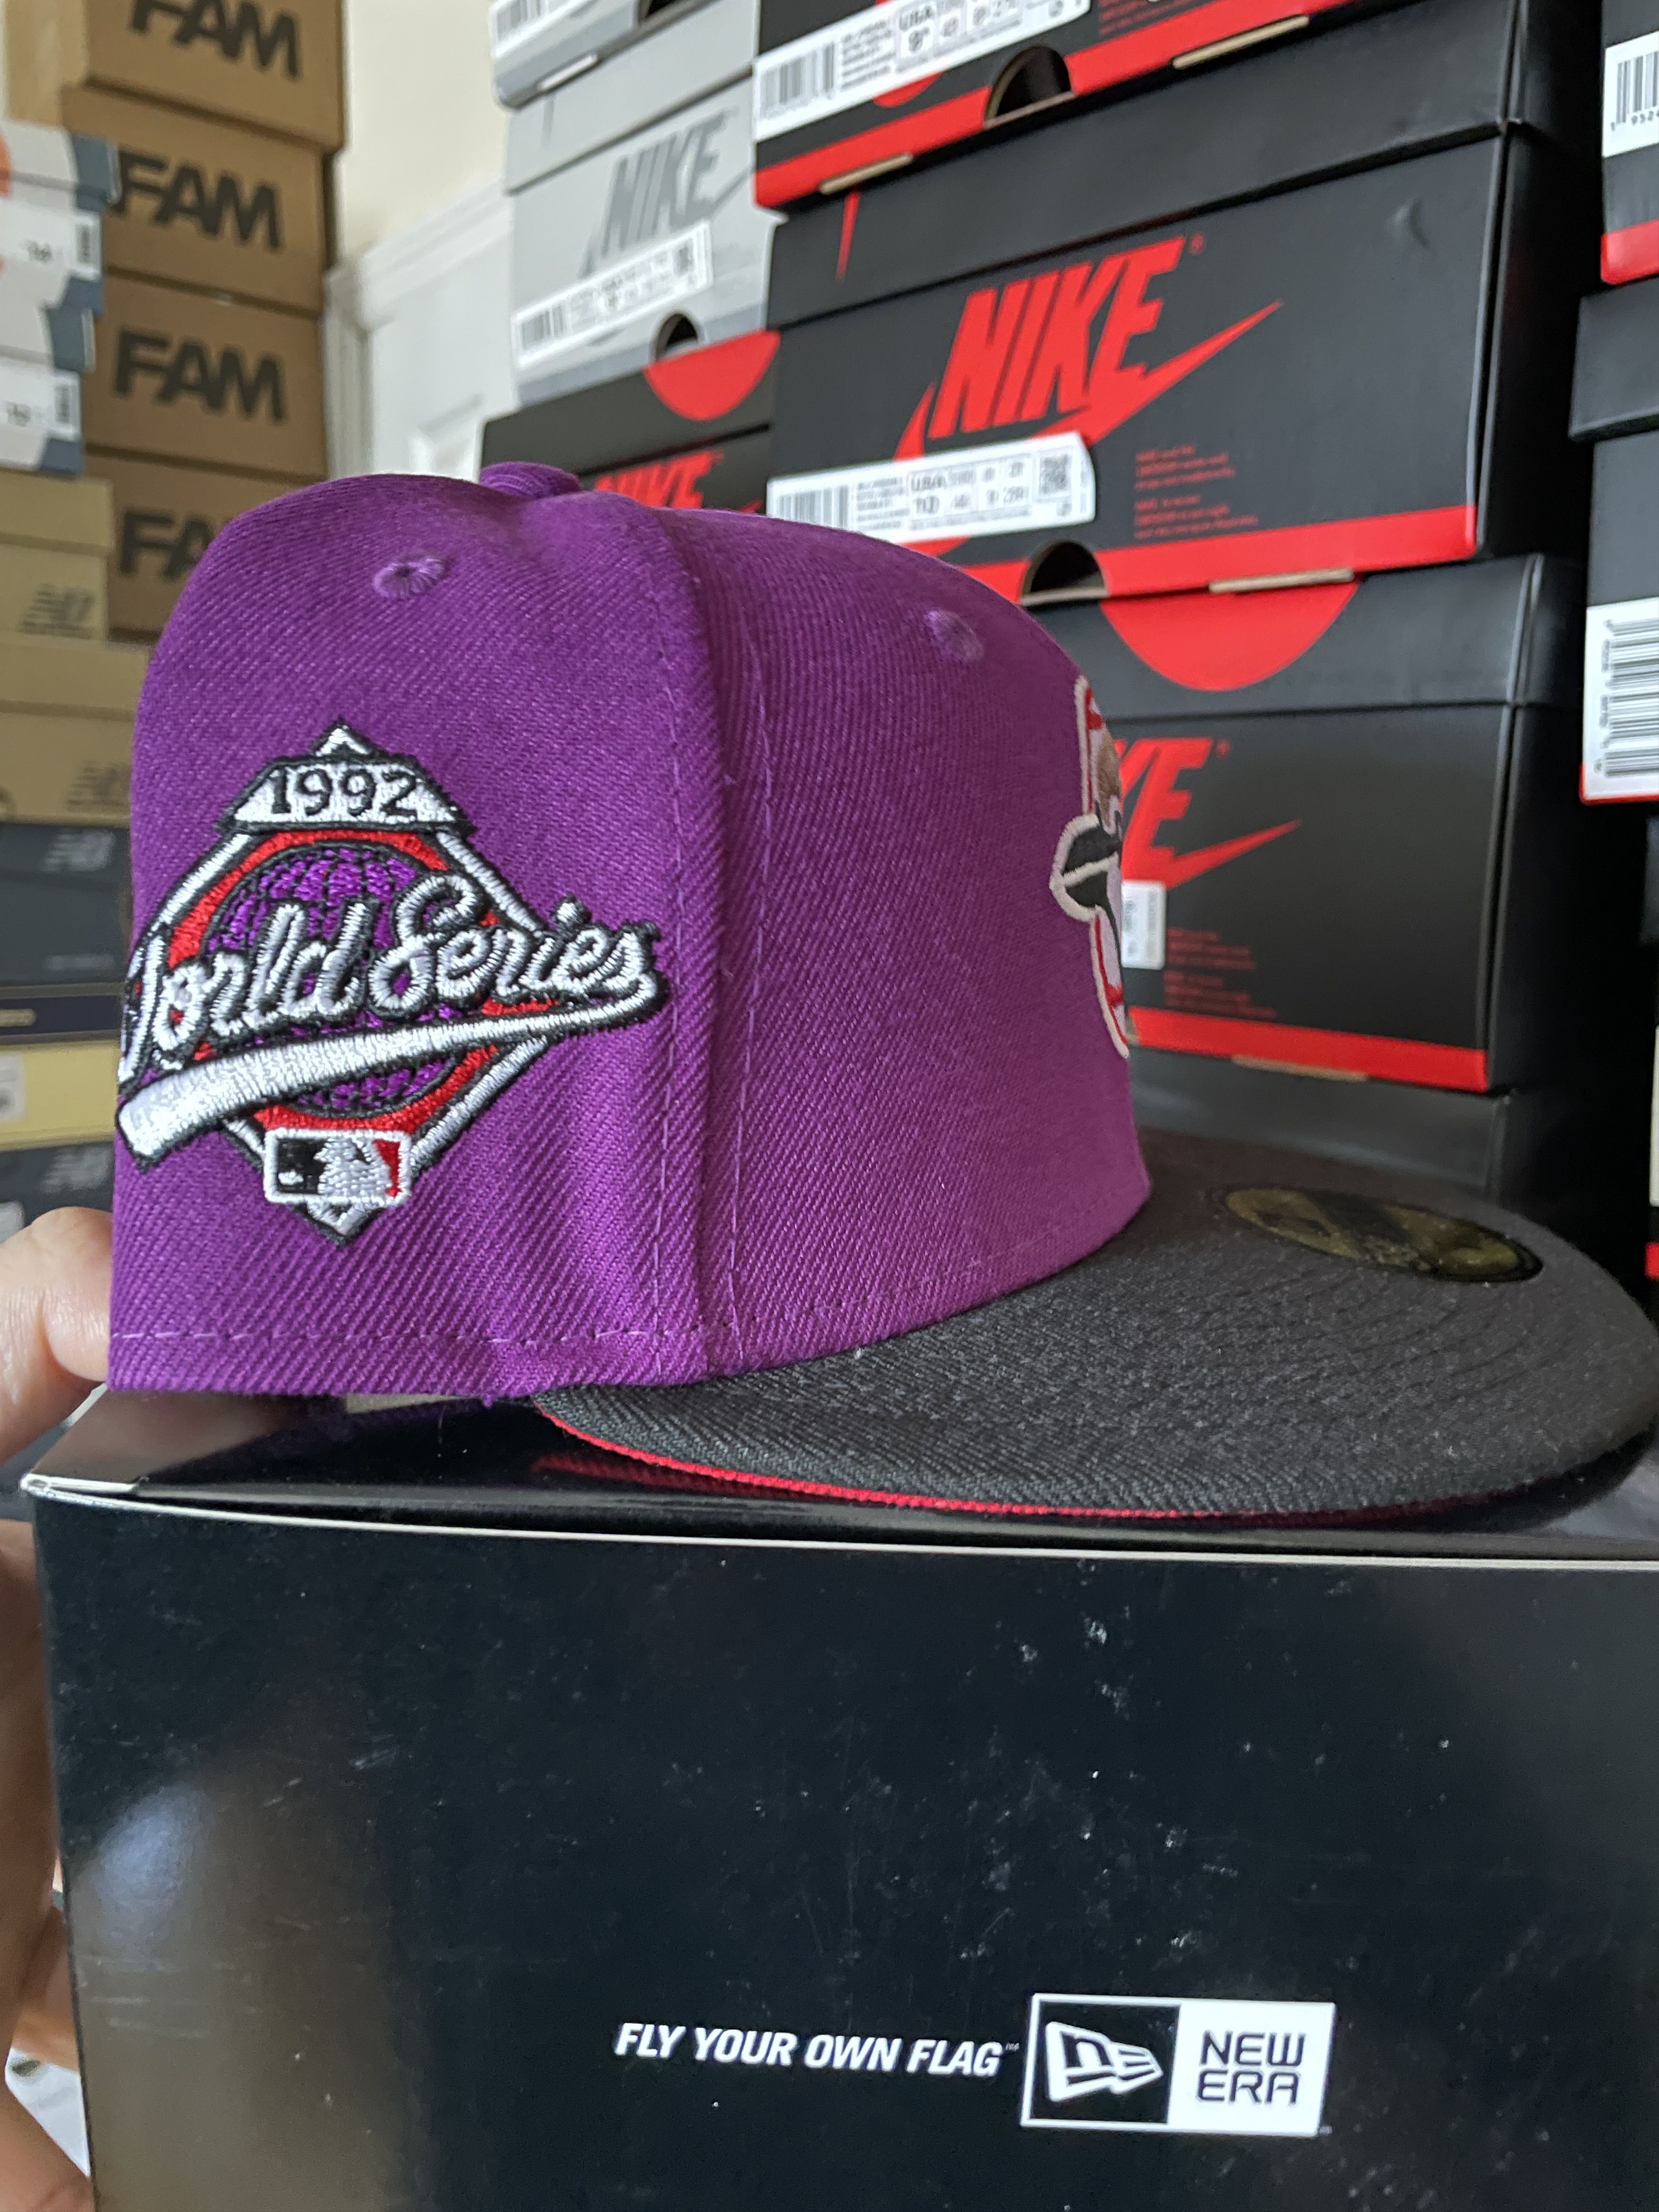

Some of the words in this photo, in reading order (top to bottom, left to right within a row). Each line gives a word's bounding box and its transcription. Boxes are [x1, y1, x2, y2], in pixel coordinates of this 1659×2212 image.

[111, 144, 281, 252] FAM
[600, 108, 730, 258] NIKE
[115, 326, 286, 422] FAM
[928, 236, 1186, 441] NIKE
[120, 510, 213, 580] FA
[262, 768, 418, 816] 1992
[367, 874, 647, 1010] Series
[614, 2022, 686, 2059] FLY
[693, 2026, 798, 2066] YOUR
[803, 2033, 902, 2071] OWN
[906, 2039, 1003, 2077] FLAG
[1197, 2069, 1302, 2105] ERA
[1200, 2030, 1306, 2066] NEW
